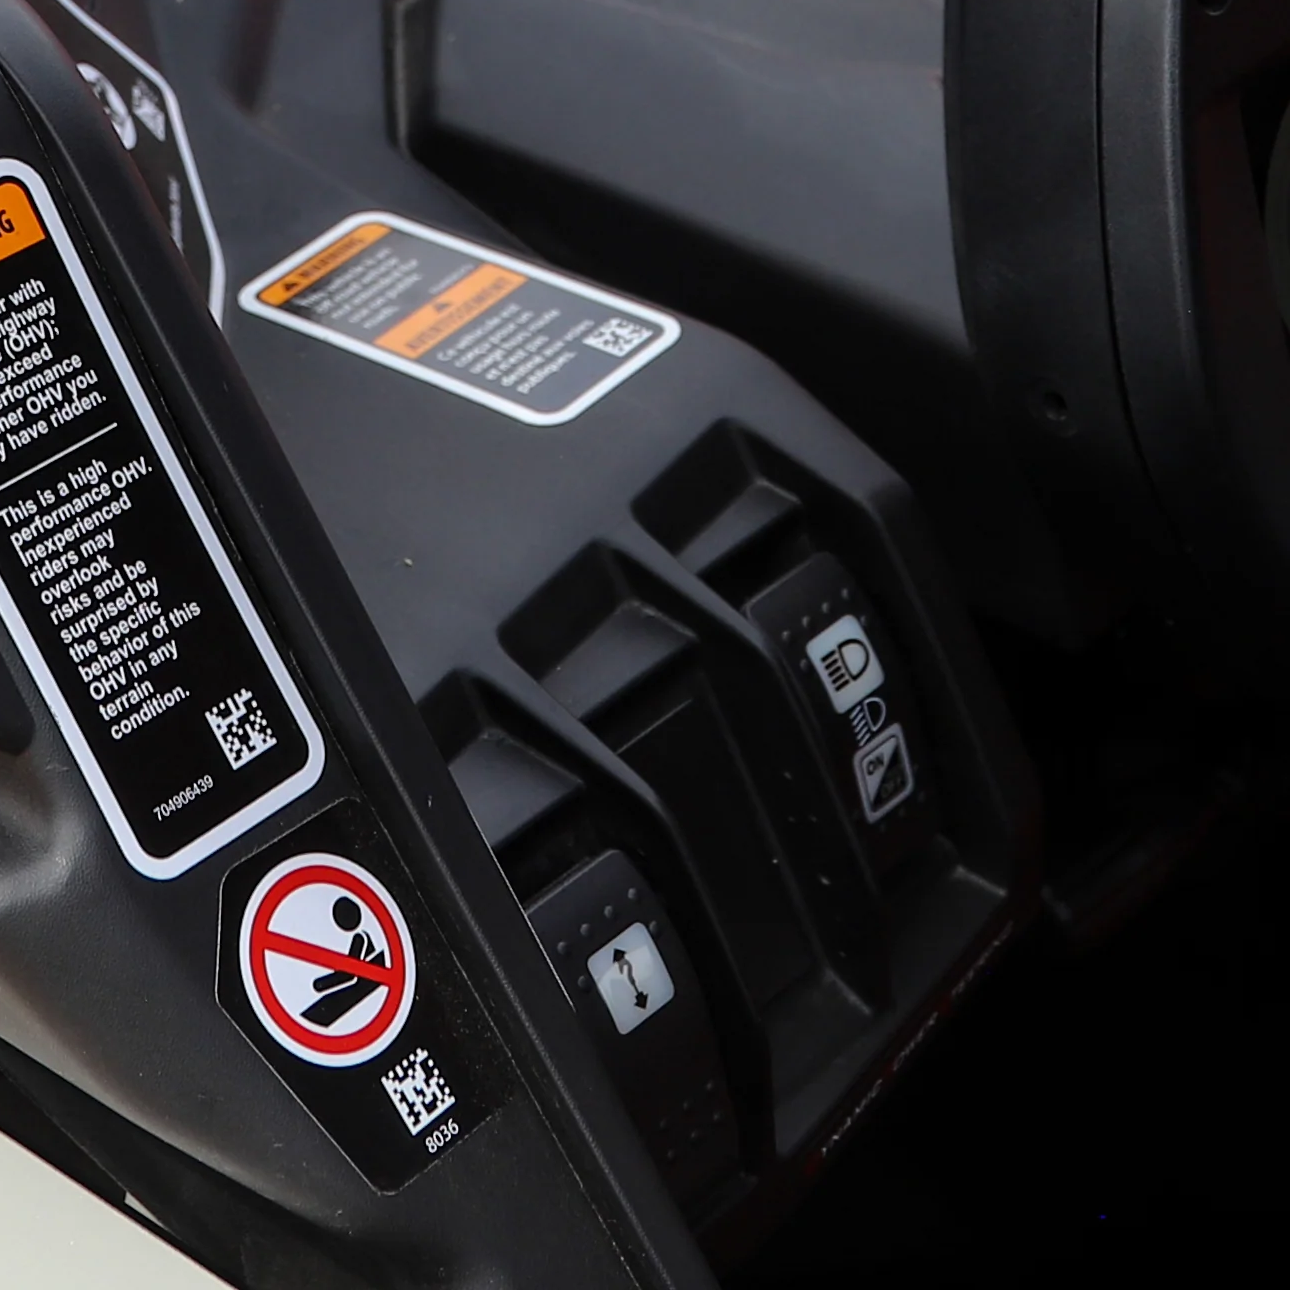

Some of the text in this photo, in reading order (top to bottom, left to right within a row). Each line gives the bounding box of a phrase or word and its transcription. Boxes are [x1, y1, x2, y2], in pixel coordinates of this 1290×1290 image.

[8, 279, 45, 305] with
[3, 313, 59, 359] (OHV);
[26, 382, 62, 414] OHV
[65, 369, 98, 398] you
[6, 420, 48, 450] have
[50, 391, 106, 427] ridden.
[10, 456, 152, 550] performance OHV.
[36, 490, 55, 507] is
[57, 482, 69, 496] a
[68, 459, 107, 489] high
[16, 491, 131, 567] Inexperienced
[30, 528, 114, 586] riders may
[41, 555, 112, 604] overlook
[50, 560, 146, 625] risks and be
[60, 577, 158, 645] surprised by
[69, 600, 162, 663] the specific
[78, 602, 200, 682] behavior of this
[90, 640, 177, 700] OHV in any
[99, 681, 154, 720] terrain
[111, 686, 189, 739] condition.
[153, 775, 213, 821] 704906439
[425, 1118, 459, 1153] 8036
